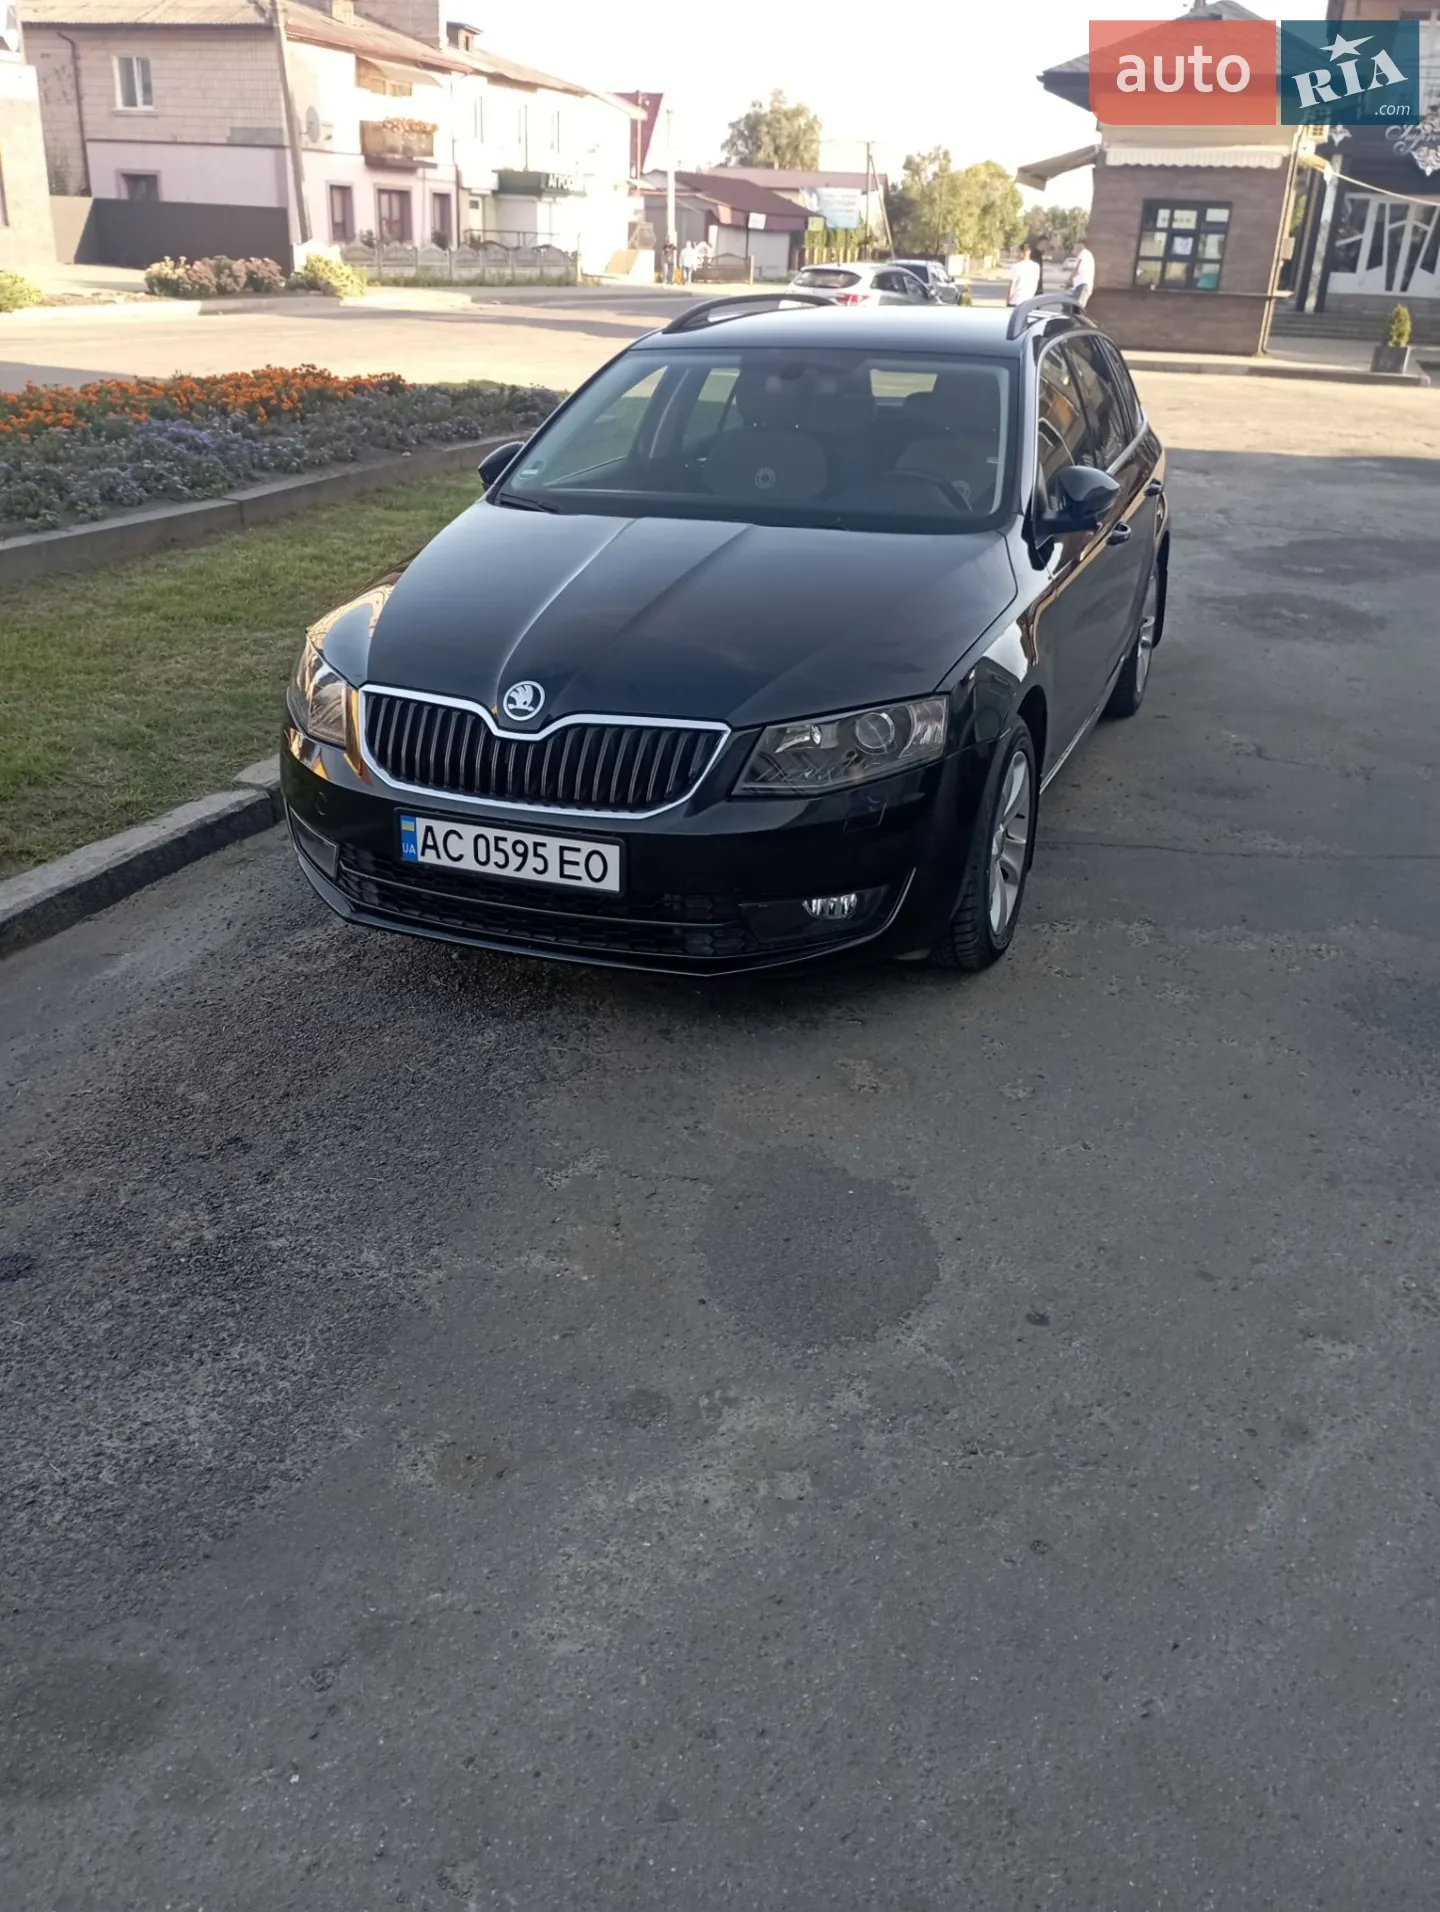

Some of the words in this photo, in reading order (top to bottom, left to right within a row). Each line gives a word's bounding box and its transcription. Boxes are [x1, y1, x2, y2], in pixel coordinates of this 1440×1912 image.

[402, 841, 416, 856] UA
[420, 825, 464, 863] AC
[473, 833, 549, 875] 0595
[558, 845, 608, 883] EO
